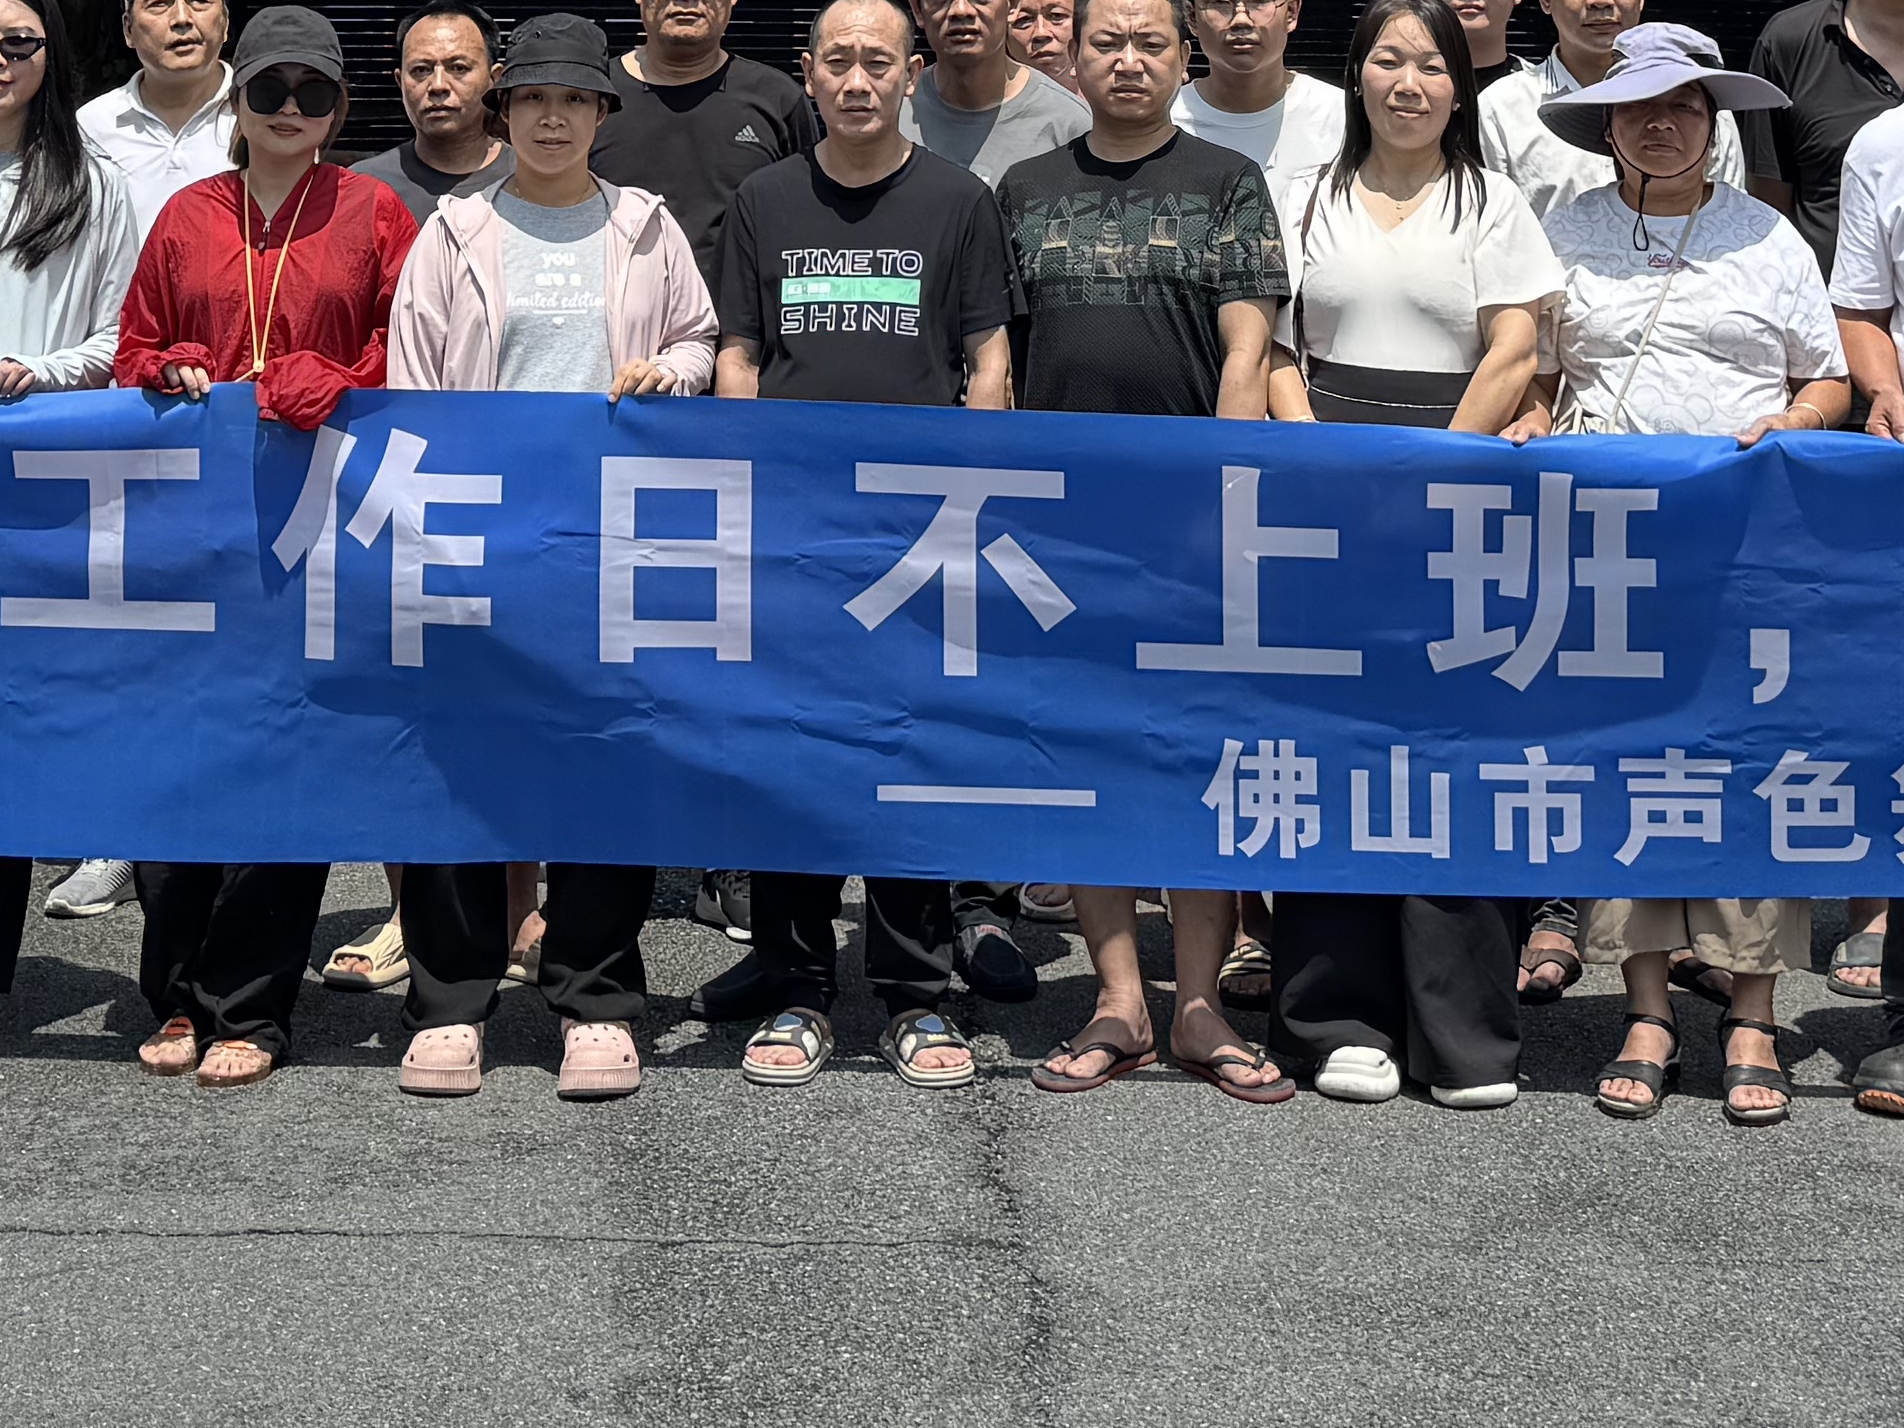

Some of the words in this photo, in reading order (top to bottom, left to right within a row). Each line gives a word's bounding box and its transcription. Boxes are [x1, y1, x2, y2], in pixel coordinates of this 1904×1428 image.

[541, 252, 575, 269] you
[782, 249, 873, 276] TIME
[877, 250, 923, 277] TO
[780, 304, 920, 336] SHINE
